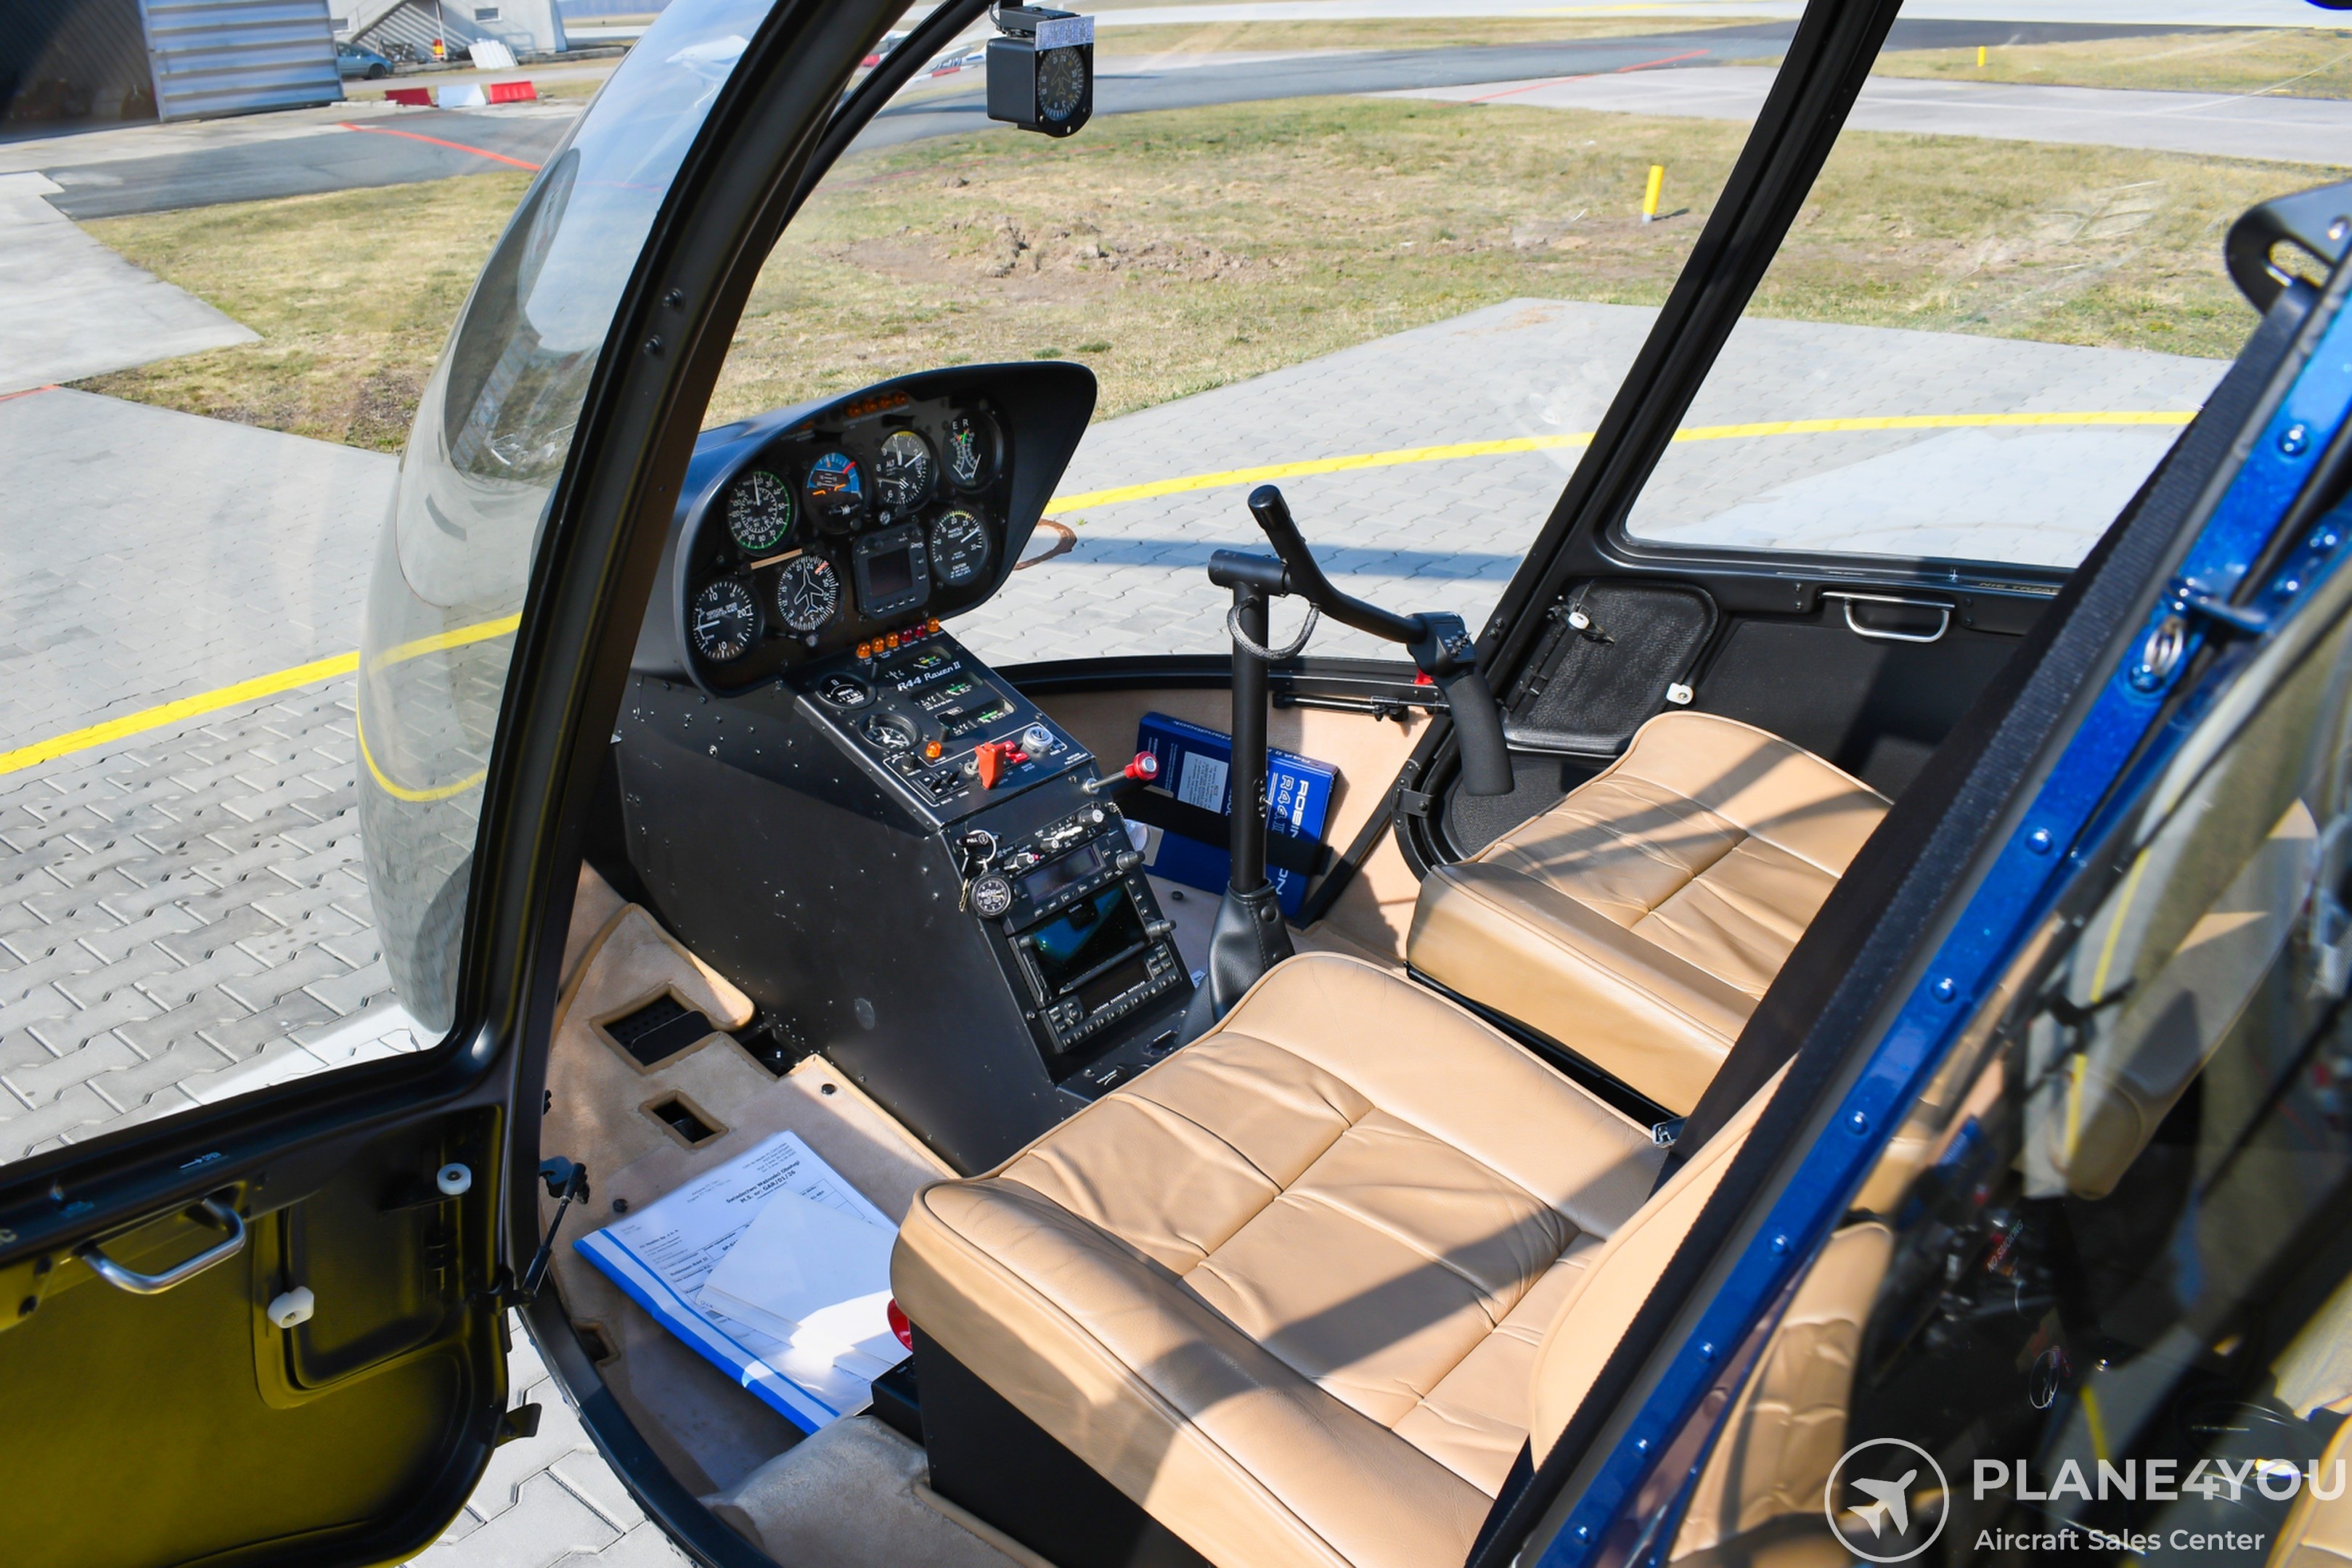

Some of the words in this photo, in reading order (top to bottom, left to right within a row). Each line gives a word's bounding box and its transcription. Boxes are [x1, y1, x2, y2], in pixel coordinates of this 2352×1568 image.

[963, 418, 969, 427] R
[709, 592, 719, 602] 10
[737, 608, 747, 618] 20
[717, 641, 727, 651] 10
[897, 676, 923, 691] R44
[923, 666, 955, 682] Raven
[1274, 774, 1295, 820] R44
